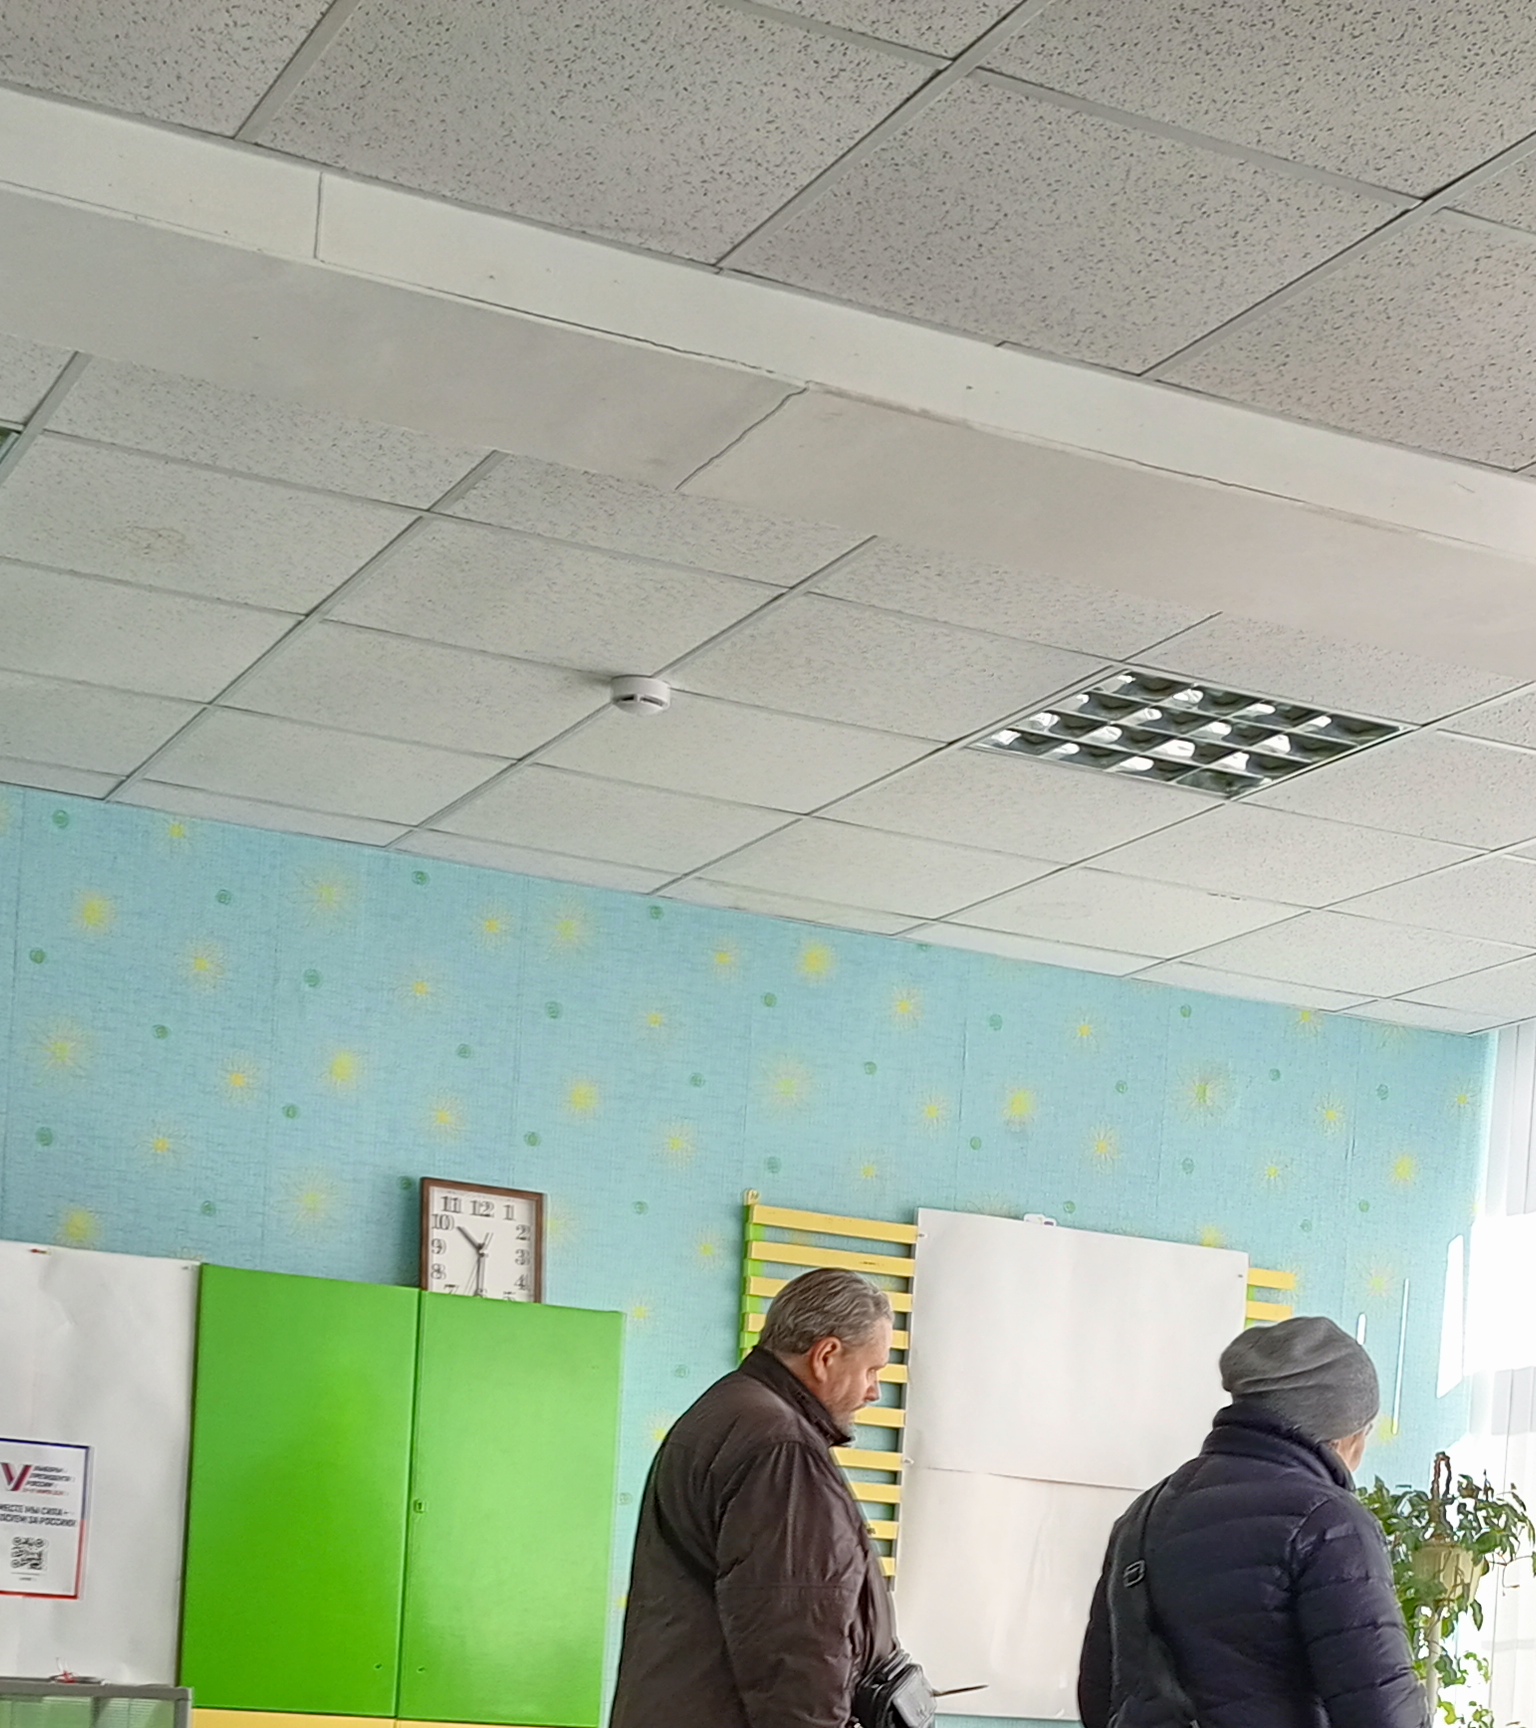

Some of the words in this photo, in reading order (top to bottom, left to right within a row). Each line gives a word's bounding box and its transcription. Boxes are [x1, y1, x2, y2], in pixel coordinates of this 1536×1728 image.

[441, 1195, 464, 1214] 11
[470, 1199, 495, 1218] 12
[502, 1204, 516, 1221] 1
[431, 1213, 455, 1231] 10
[515, 1224, 531, 1241] 2
[431, 1238, 447, 1255] 9
[515, 1248, 531, 1265] 3
[431, 1263, 447, 1280] 8
[513, 1273, 532, 1292] 4
